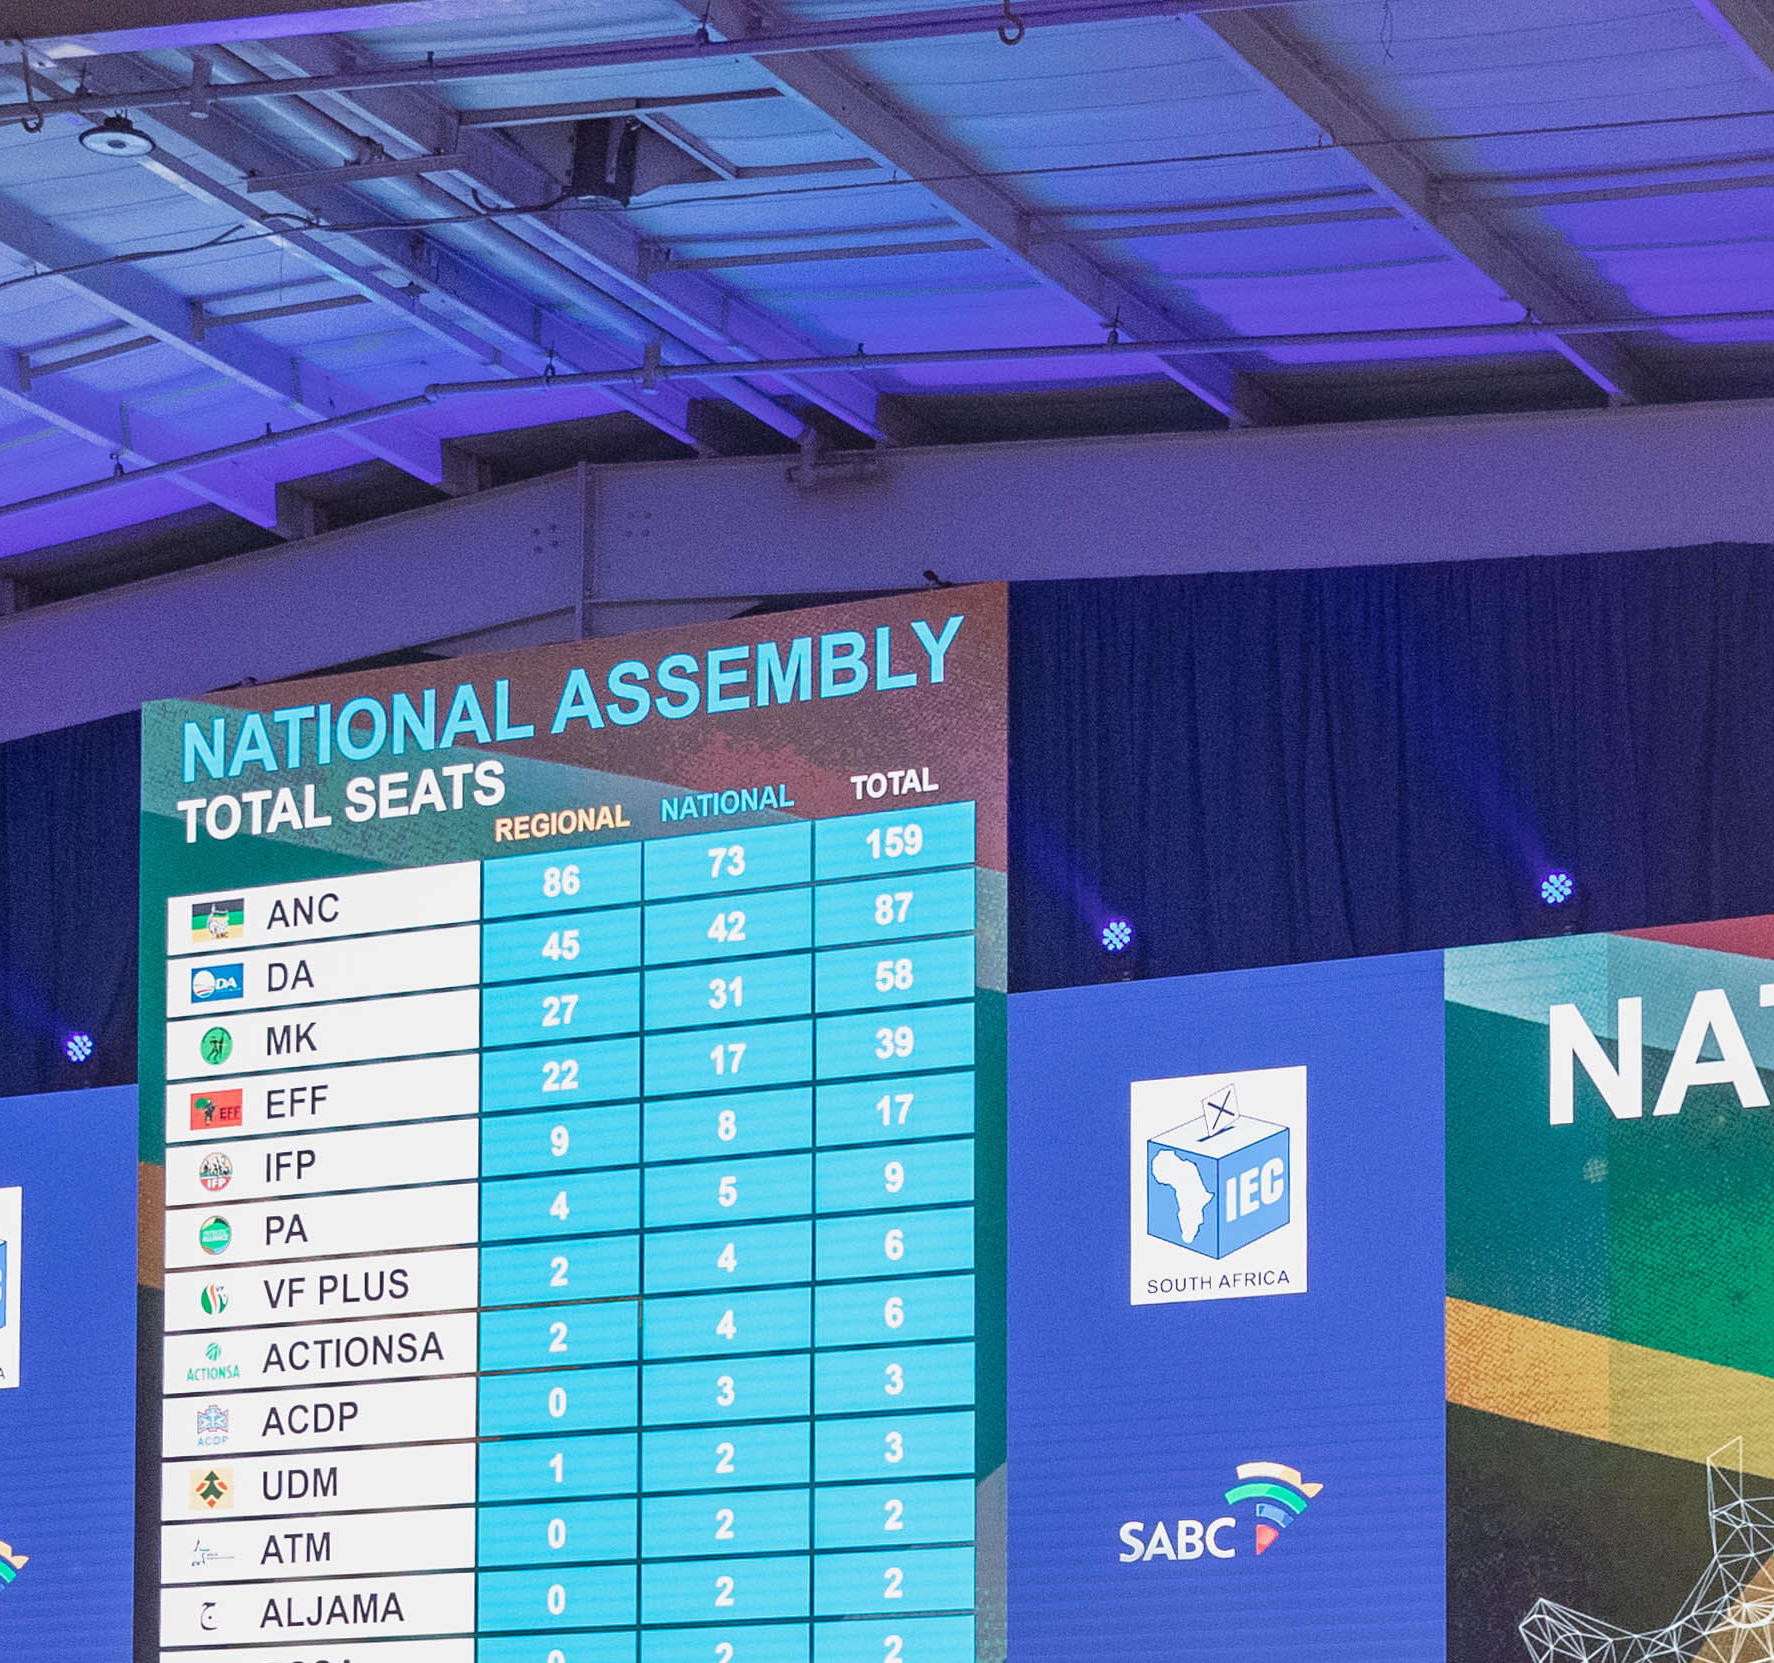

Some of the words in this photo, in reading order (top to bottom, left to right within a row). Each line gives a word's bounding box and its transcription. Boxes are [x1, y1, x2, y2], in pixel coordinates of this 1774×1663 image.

[182, 679, 534, 782] NATIONAL
[551, 615, 964, 734] ASSEMBLY
[177, 784, 331, 843] TOTAL
[345, 760, 505, 822] SEATS
[495, 804, 630, 842] REGIONAL
[660, 785, 794, 822] NATIONAL
[850, 767, 938, 799] TOTAL
[267, 893, 338, 929] ANC
[543, 865, 580, 897] 86
[708, 845, 745, 877] 73
[866, 824, 923, 859] 159
[268, 960, 314, 992] DA
[542, 930, 580, 960] 45
[708, 911, 746, 942] 42
[875, 892, 913, 925] 87
[216, 977, 237, 990] DA
[267, 1022, 316, 1055] MK
[542, 994, 579, 1026] 27
[709, 976, 742, 1009] 31
[876, 958, 913, 992] 58
[267, 1085, 328, 1119] EFF
[542, 1059, 578, 1092] 22
[710, 1043, 746, 1074] 17
[876, 1026, 914, 1059] 39
[220, 1106, 240, 1119] EFF
[267, 1150, 315, 1182] IFP
[551, 1126, 569, 1156] 9
[718, 1110, 736, 1141] 8
[876, 1093, 914, 1126] 17
[207, 1178, 226, 1188] IFP
[266, 1214, 307, 1245] PA
[550, 1191, 569, 1220] 4
[719, 1176, 737, 1207] 5
[885, 1162, 904, 1192] 9
[1226, 1158, 1285, 1221] IEC
[264, 1278, 305, 1308] VF
[320, 1269, 408, 1305] PLUS
[550, 1256, 568, 1286] 2
[717, 1243, 737, 1272] 4
[885, 1229, 904, 1260] 6
[1147, 1276, 1211, 1294] SOUTH
[1219, 1270, 1290, 1288] AFRICA
[263, 1332, 443, 1373] ACTIONSA
[549, 1322, 567, 1352] 2
[716, 1310, 736, 1339] 4
[884, 1297, 904, 1328] 6
[187, 1365, 239, 1381] ACTIONSA
[262, 1402, 358, 1436] ACDP
[549, 1387, 566, 1417] 0
[717, 1376, 734, 1406] 3
[885, 1364, 903, 1395] 3
[197, 1436, 228, 1446] ACDP
[263, 1467, 337, 1500] UDM
[549, 1453, 563, 1483] 1
[716, 1443, 734, 1473] 2
[885, 1432, 903, 1463] 3
[261, 1532, 330, 1564] ATM
[548, 1518, 566, 1549] 0
[716, 1509, 734, 1539] 2
[884, 1499, 903, 1530] 2
[1120, 1517, 1235, 1562] SABC
[260, 1593, 404, 1628] ALJAMA
[548, 1584, 565, 1615] 0
[715, 1576, 734, 1606] 2
[884, 1568, 903, 1598] 2
